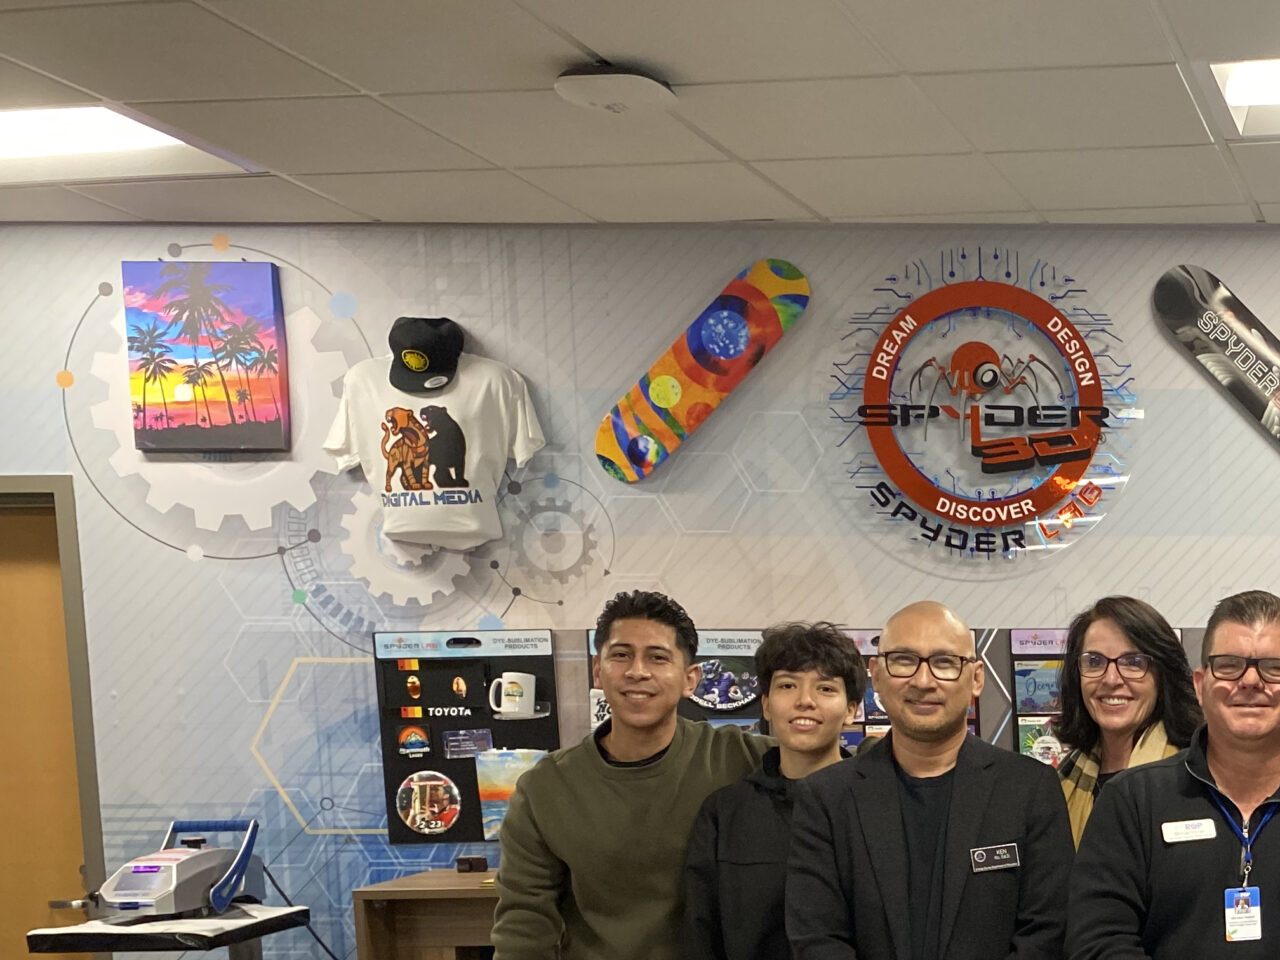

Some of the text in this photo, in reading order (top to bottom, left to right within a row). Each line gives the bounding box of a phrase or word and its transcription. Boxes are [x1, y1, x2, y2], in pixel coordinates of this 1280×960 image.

[871, 313, 918, 381] DREAM
[1046, 316, 1096, 387] DESIGN
[1197, 310, 1280, 397] SPYDER
[857, 404, 1110, 428] SPYDER
[381, 489, 483, 507] DIGITAL MEDIA
[935, 497, 1037, 523] DISCOVER
[870, 480, 1027, 553] SPYDER
[427, 706, 472, 717] TOYOTA
[716, 692, 757, 709] BECKHAM
